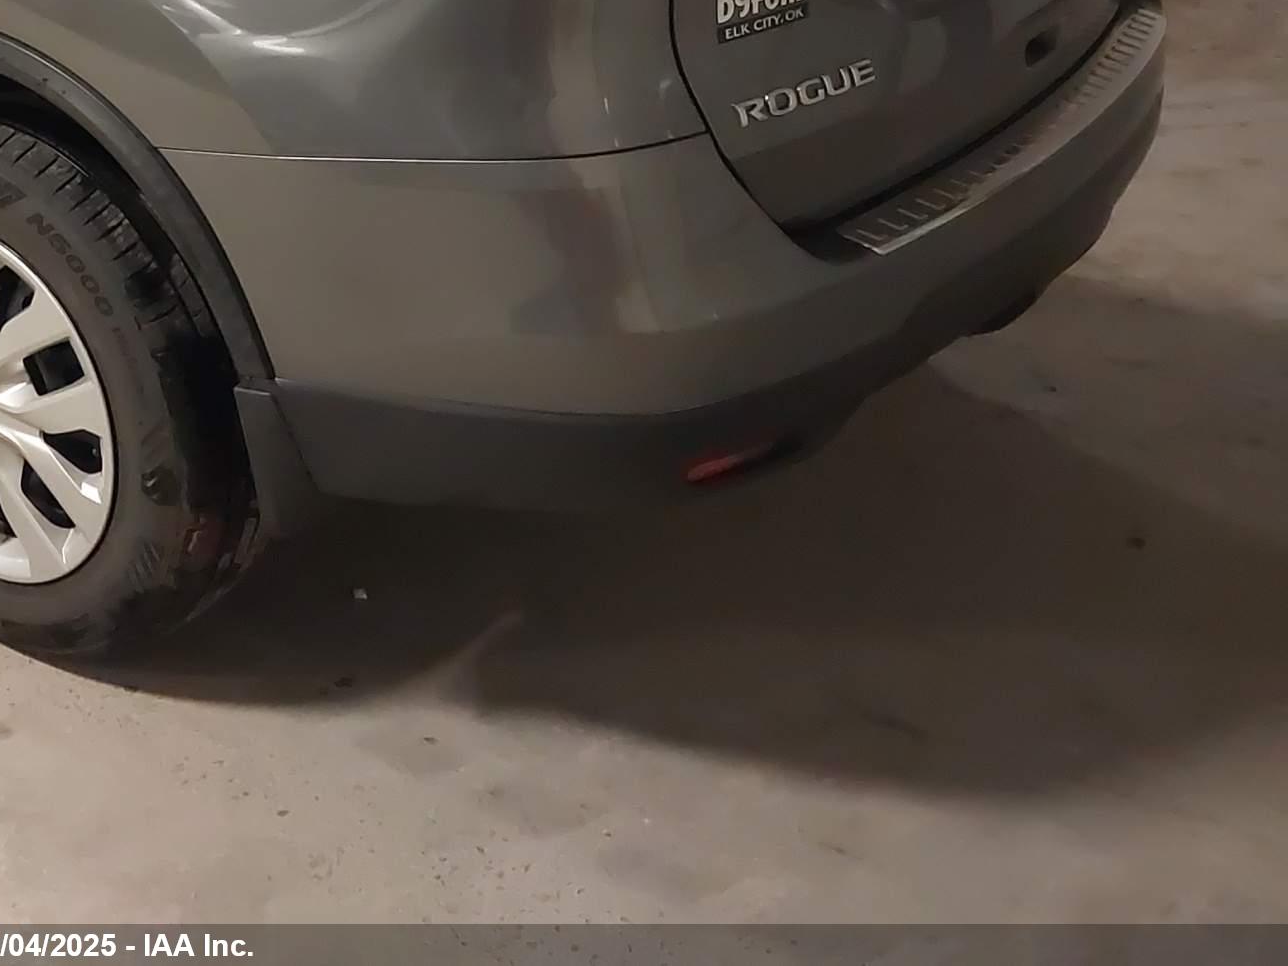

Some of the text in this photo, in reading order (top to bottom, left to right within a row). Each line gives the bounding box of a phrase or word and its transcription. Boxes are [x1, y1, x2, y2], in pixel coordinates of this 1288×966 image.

[725, 23, 751, 40] ELK
[785, 7, 804, 22] OK
[731, 58, 876, 128] ROGUE
